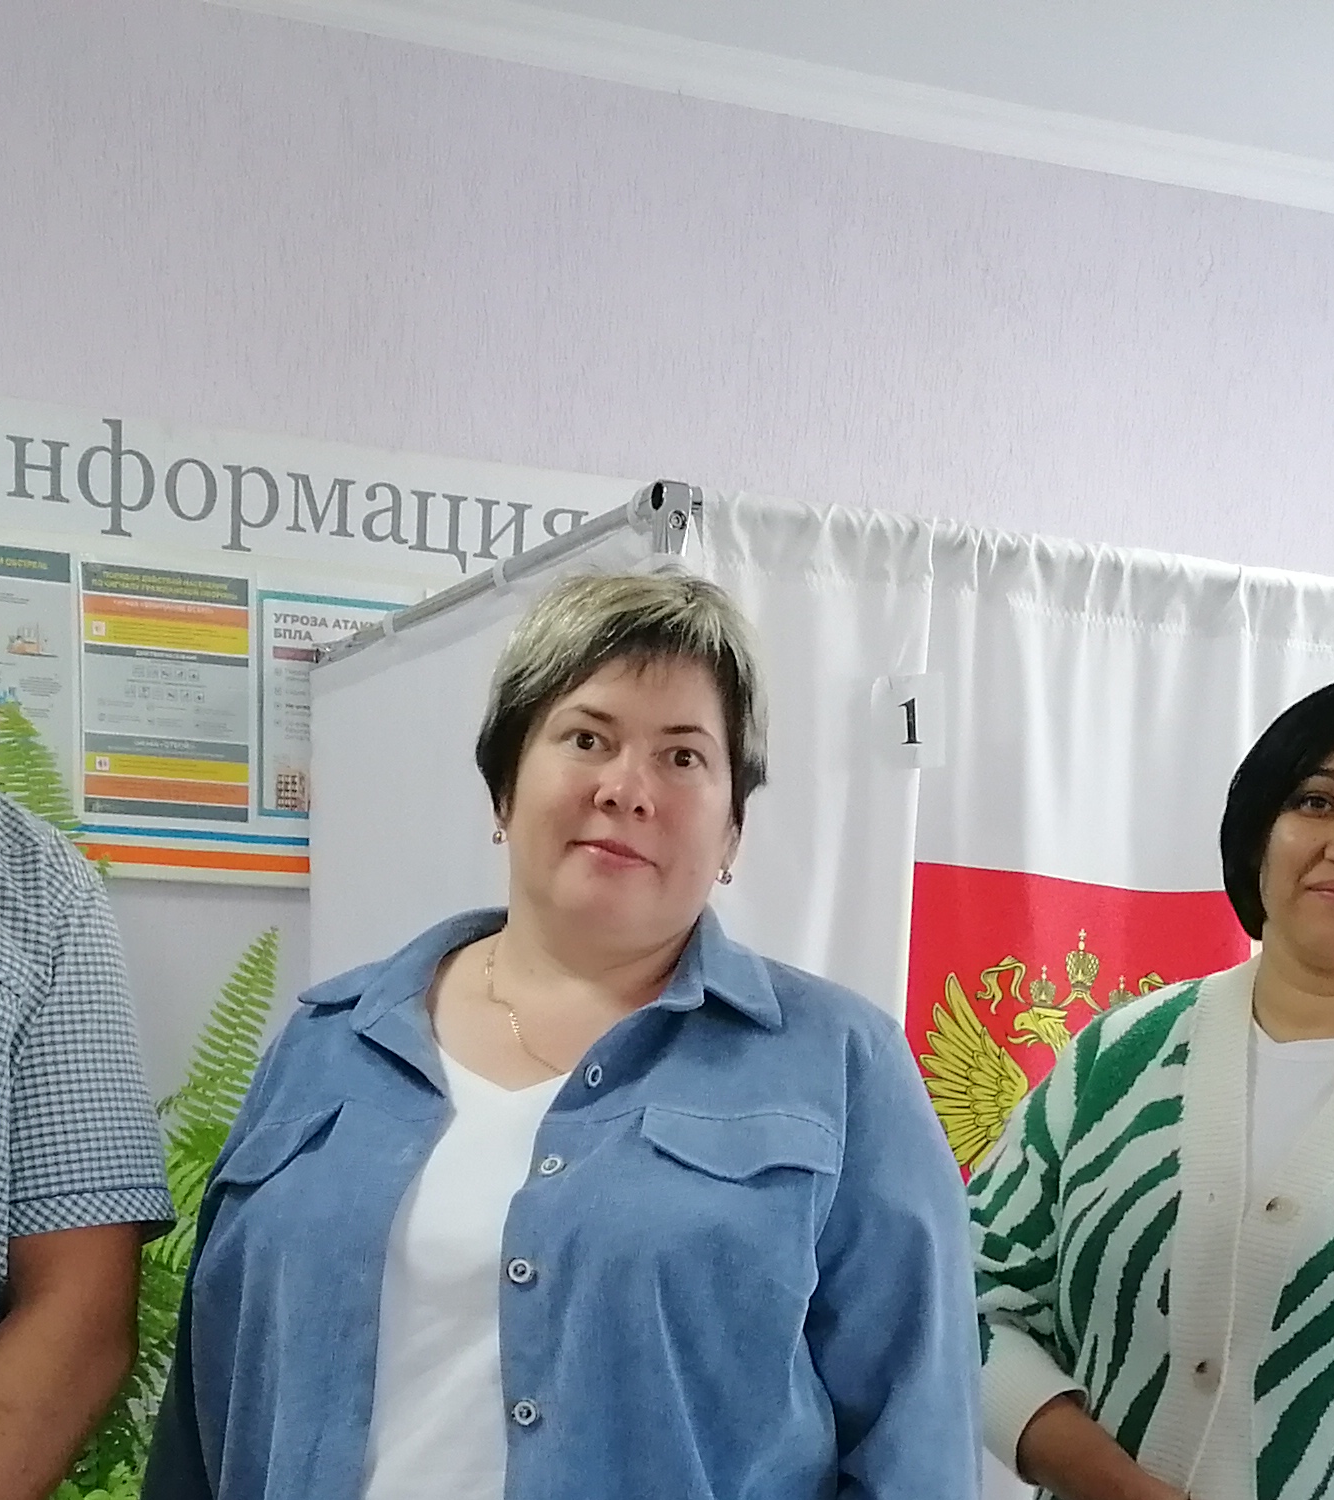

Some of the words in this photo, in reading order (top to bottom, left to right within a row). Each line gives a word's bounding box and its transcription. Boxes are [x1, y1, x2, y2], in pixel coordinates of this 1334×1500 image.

[273, 612, 329, 628] УГРОЗА
[273, 628, 314, 642] БПЛА
[898, 697, 923, 745] 1
